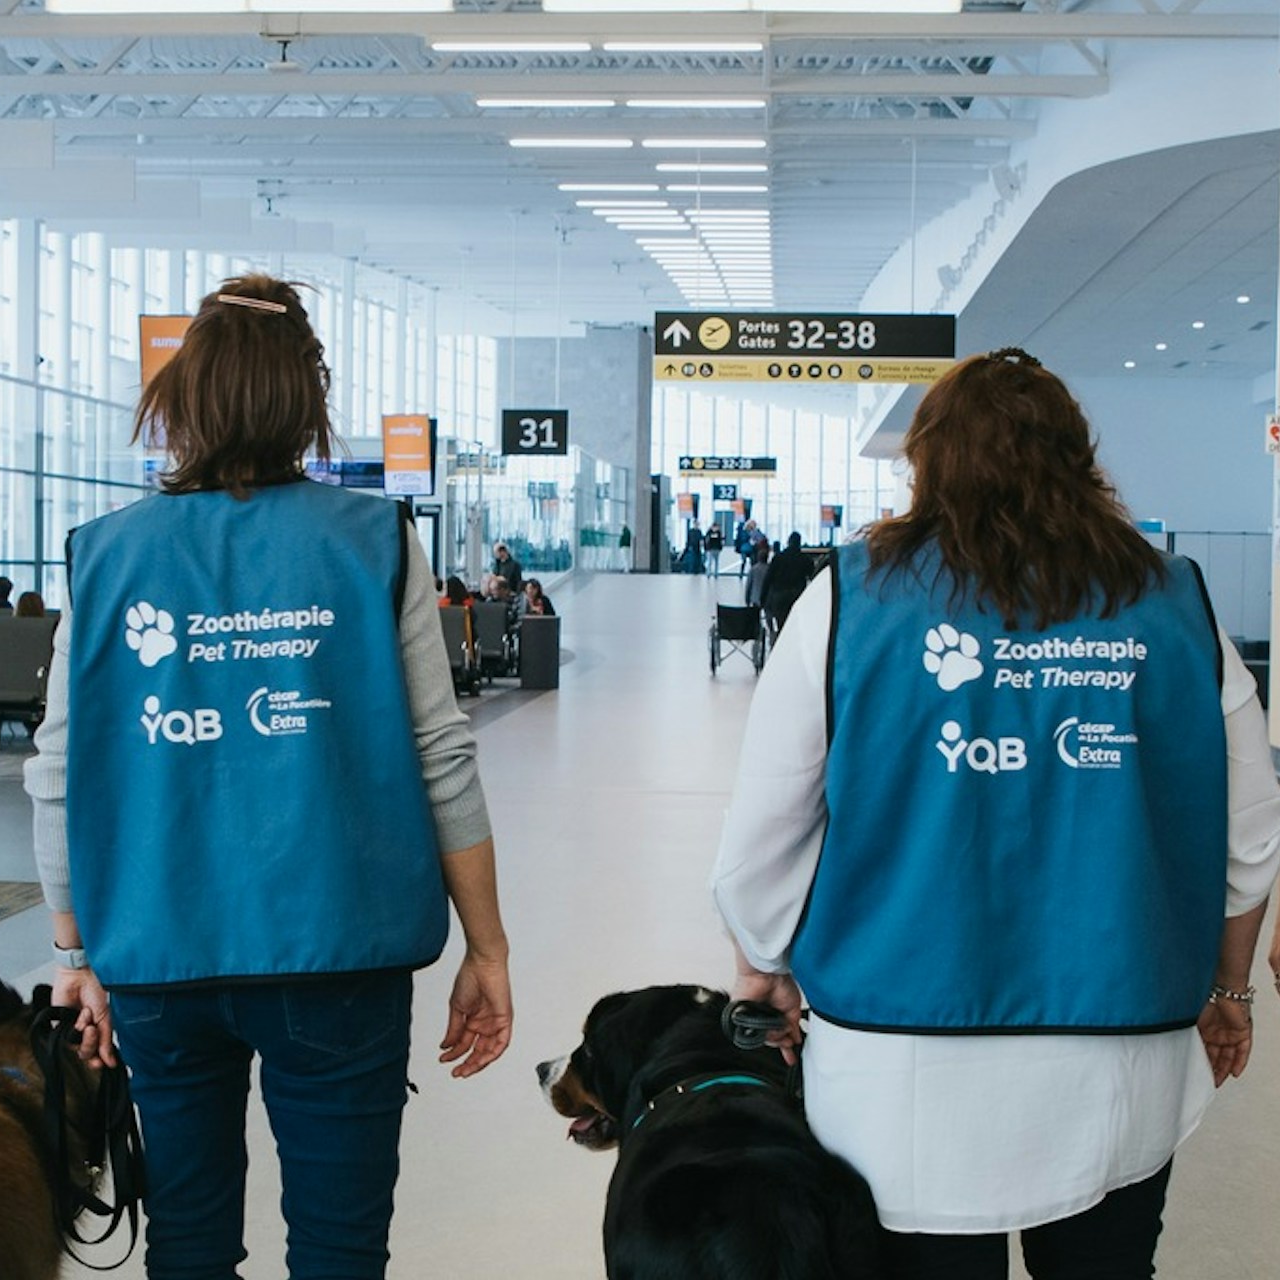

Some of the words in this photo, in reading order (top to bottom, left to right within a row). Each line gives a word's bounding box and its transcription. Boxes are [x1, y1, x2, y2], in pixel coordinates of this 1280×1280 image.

[738, 320, 780, 334] Portes
[787, 320, 876, 349] 32-38
[738, 335, 776, 349] Gates
[518, 417, 558, 448] 31
[721, 458, 753, 469] 32-38
[719, 487, 734, 498] 32
[187, 605, 335, 636] Zoothérapie
[188, 643, 226, 663] Pet
[232, 638, 320, 659] Therapy
[993, 636, 1148, 662] Zoothérapie
[994, 669, 1034, 689] Pet
[1040, 667, 1136, 691] Therapy
[140, 695, 223, 745] YQB
[271, 714, 307, 730] Extra
[936, 720, 1028, 774] YQB
[1079, 746, 1121, 763] Extra
